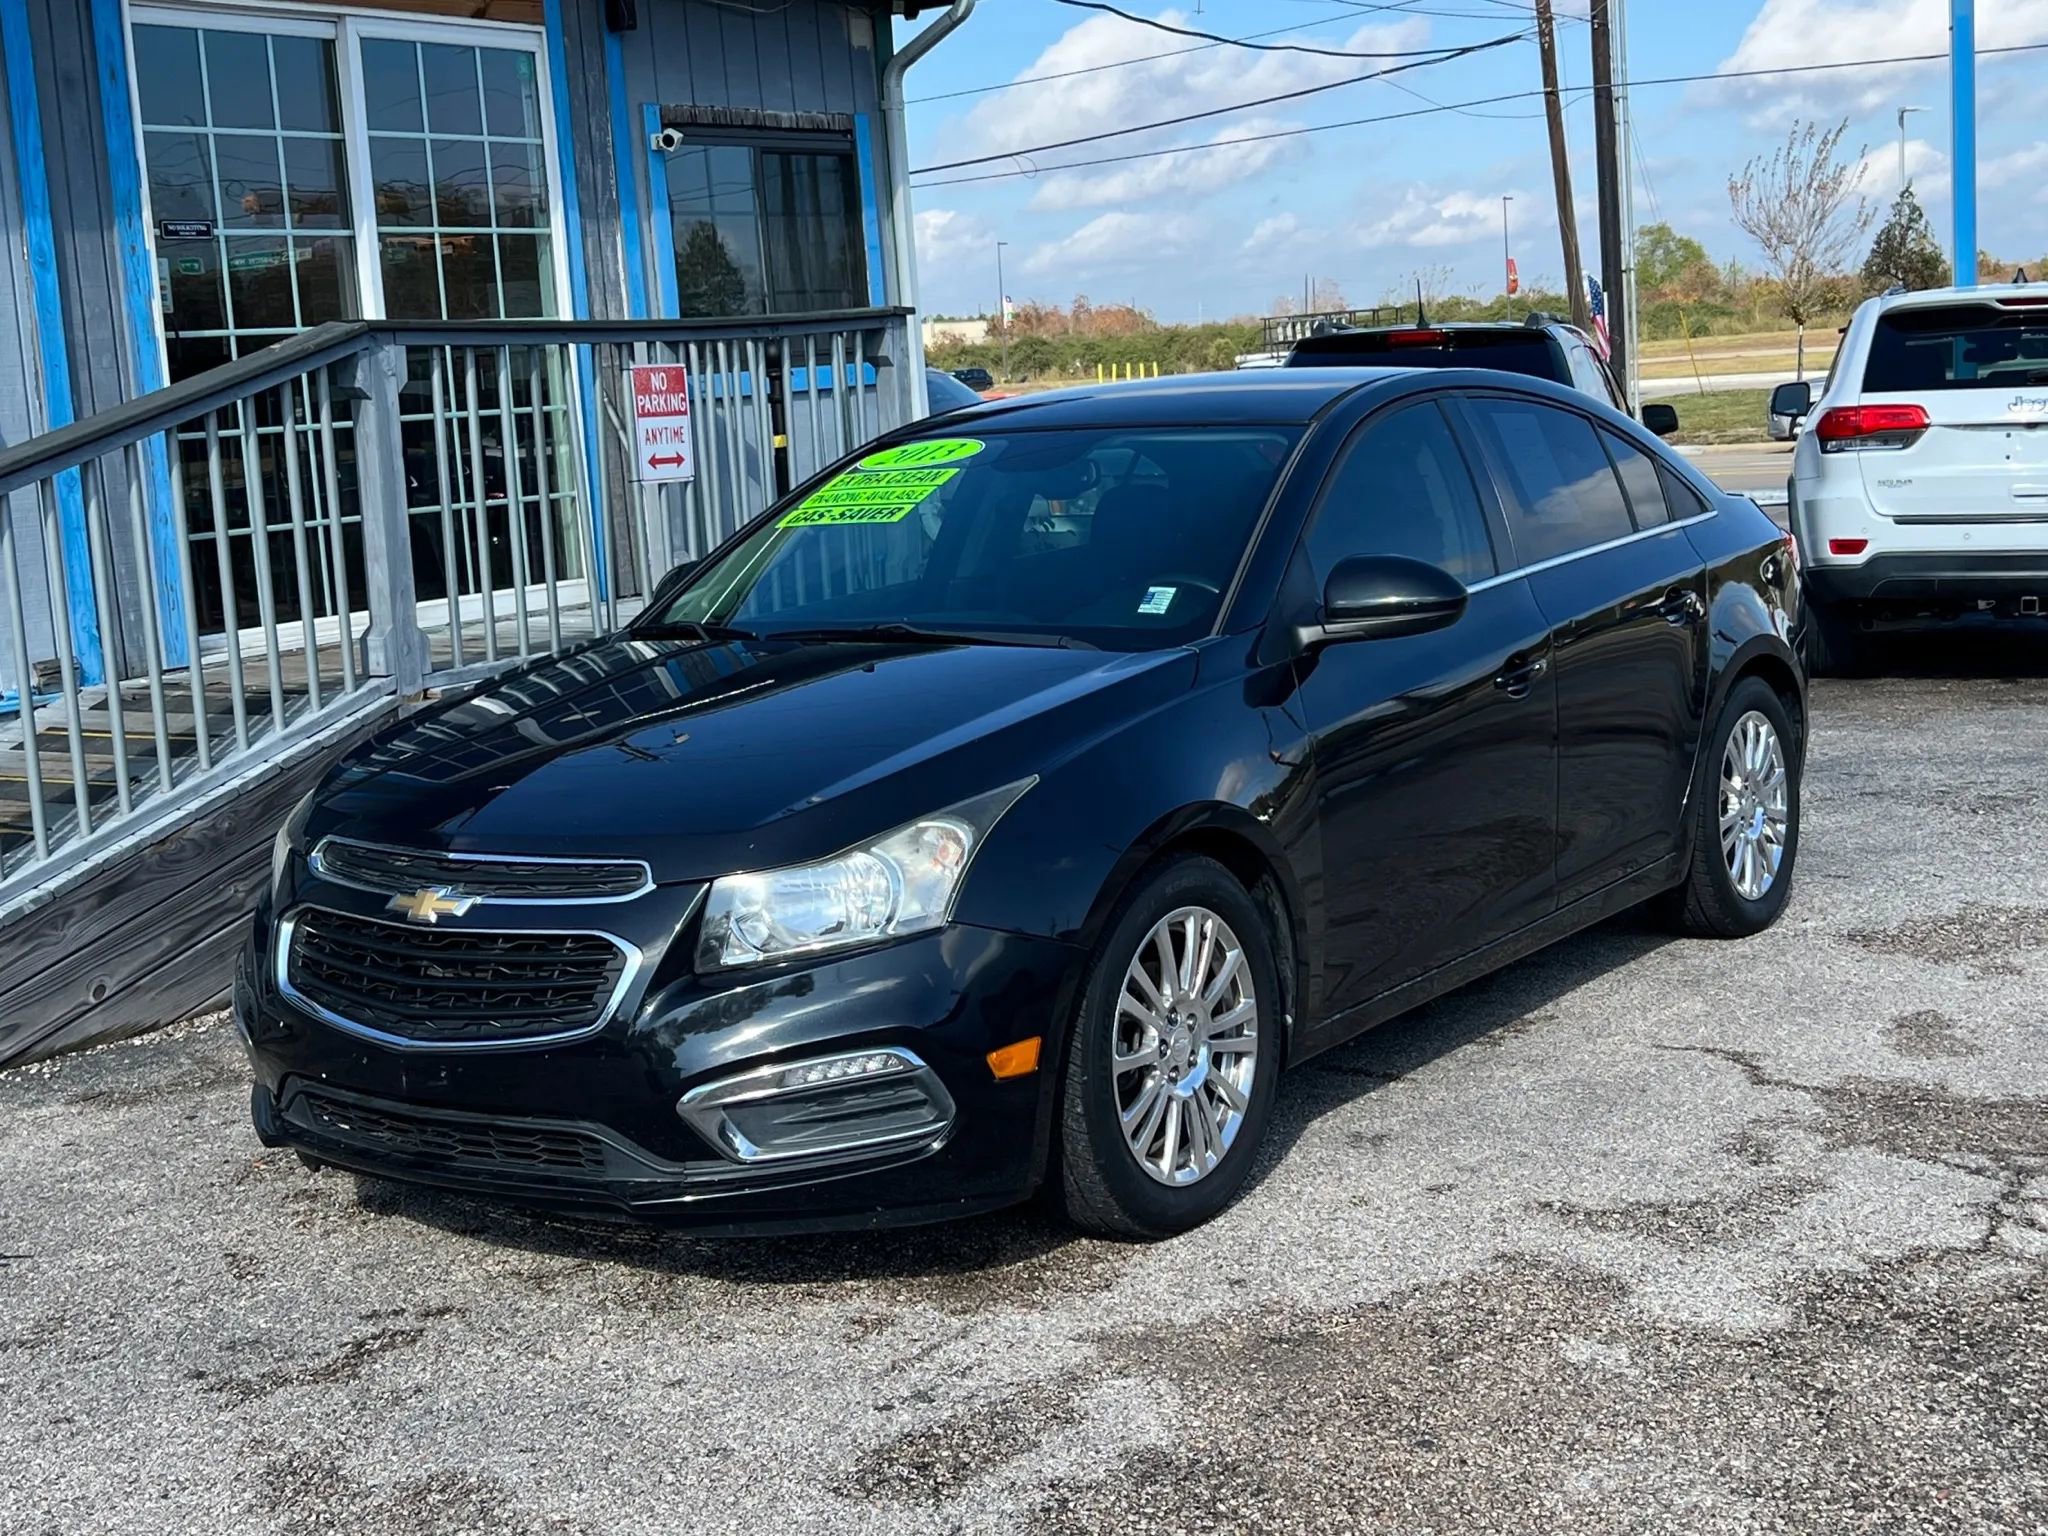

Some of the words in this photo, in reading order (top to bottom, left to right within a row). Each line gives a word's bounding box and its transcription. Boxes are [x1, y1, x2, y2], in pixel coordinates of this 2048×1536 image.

[650, 372, 668, 391] NO
[638, 393, 686, 414] PARKING
[2007, 395, 2048, 415] Jee
[645, 426, 685, 446] ANYTIME
[874, 442, 968, 467] 2013
[831, 472, 889, 488] EXTRA
[884, 470, 945, 485] CLEAN
[863, 489, 926, 504] AVAILABLE
[786, 506, 905, 525] GAS-SAVER
